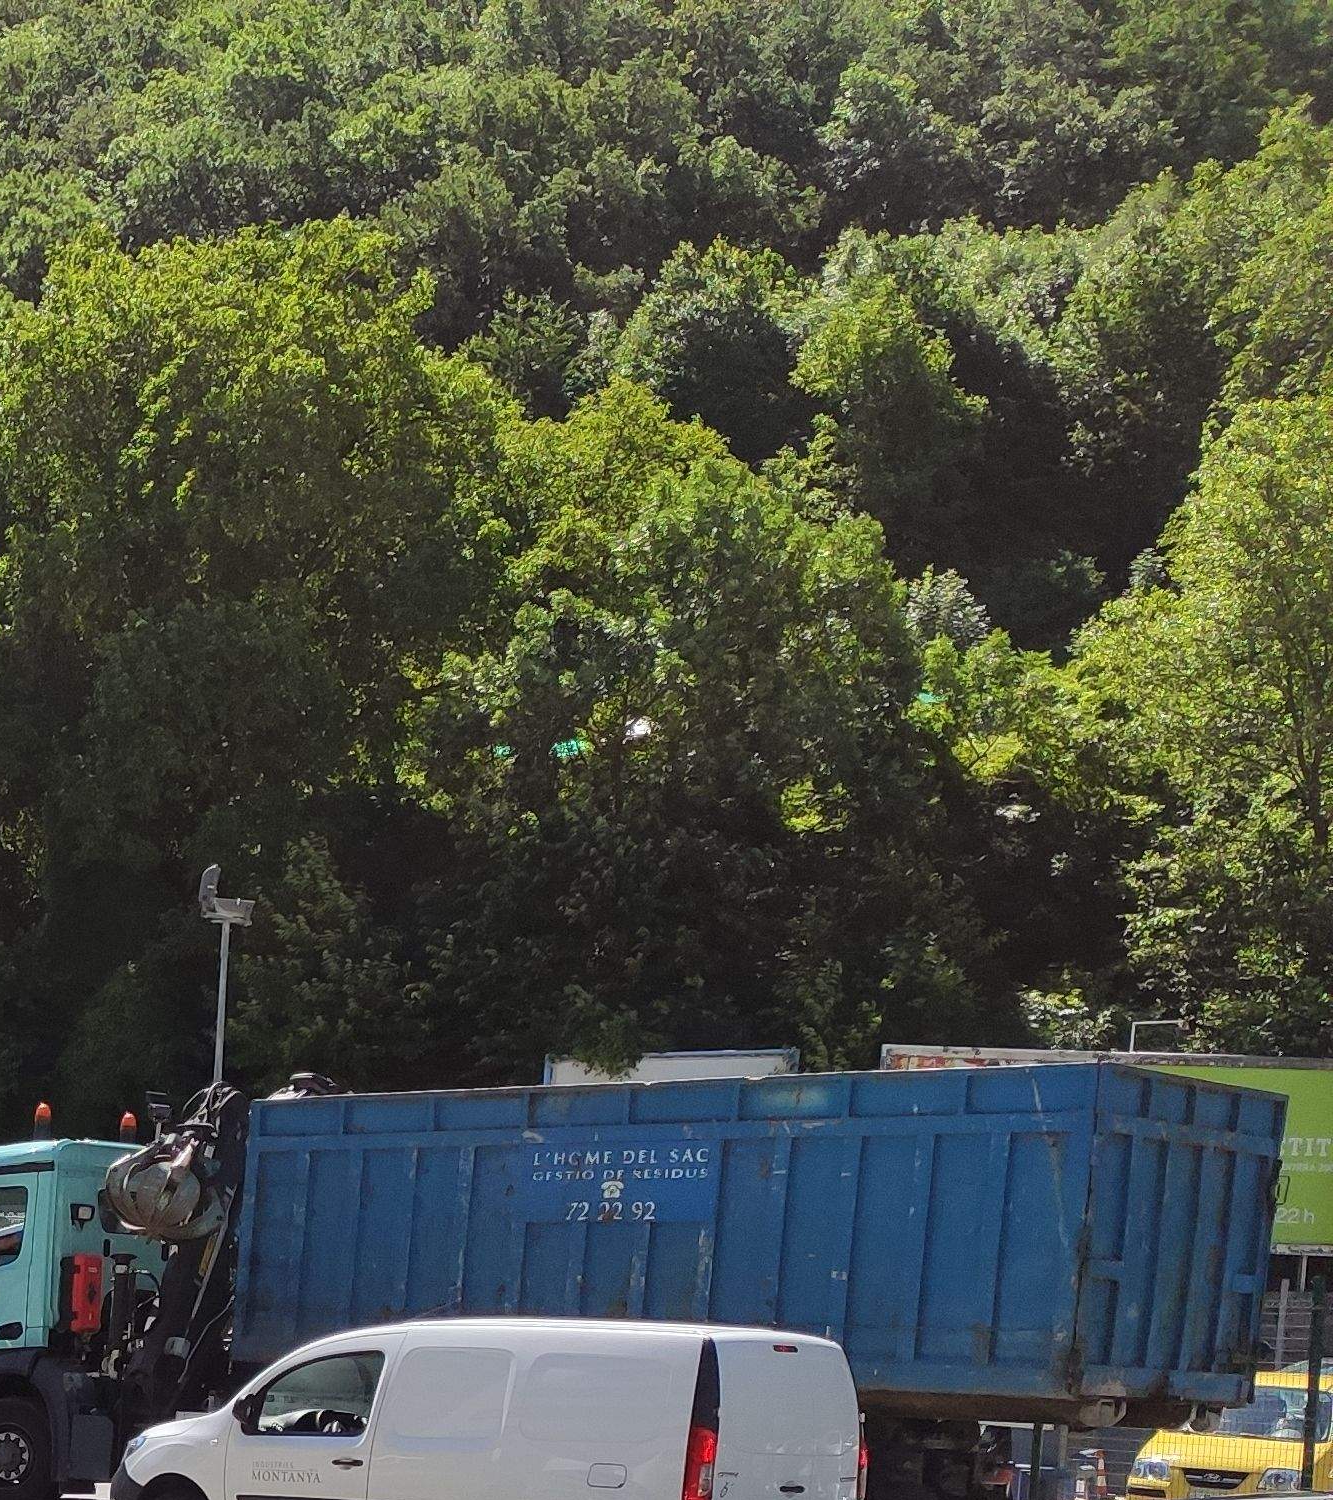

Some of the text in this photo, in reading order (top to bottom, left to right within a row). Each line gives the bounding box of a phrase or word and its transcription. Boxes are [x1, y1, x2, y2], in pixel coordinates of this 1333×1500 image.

[623, 1149, 657, 1165] DEL
[669, 1148, 709, 1164] SAC
[633, 1168, 709, 1180] RESIDUS
[632, 1201, 656, 1221] 92
[252, 1470, 321, 1484] MONTANYA
